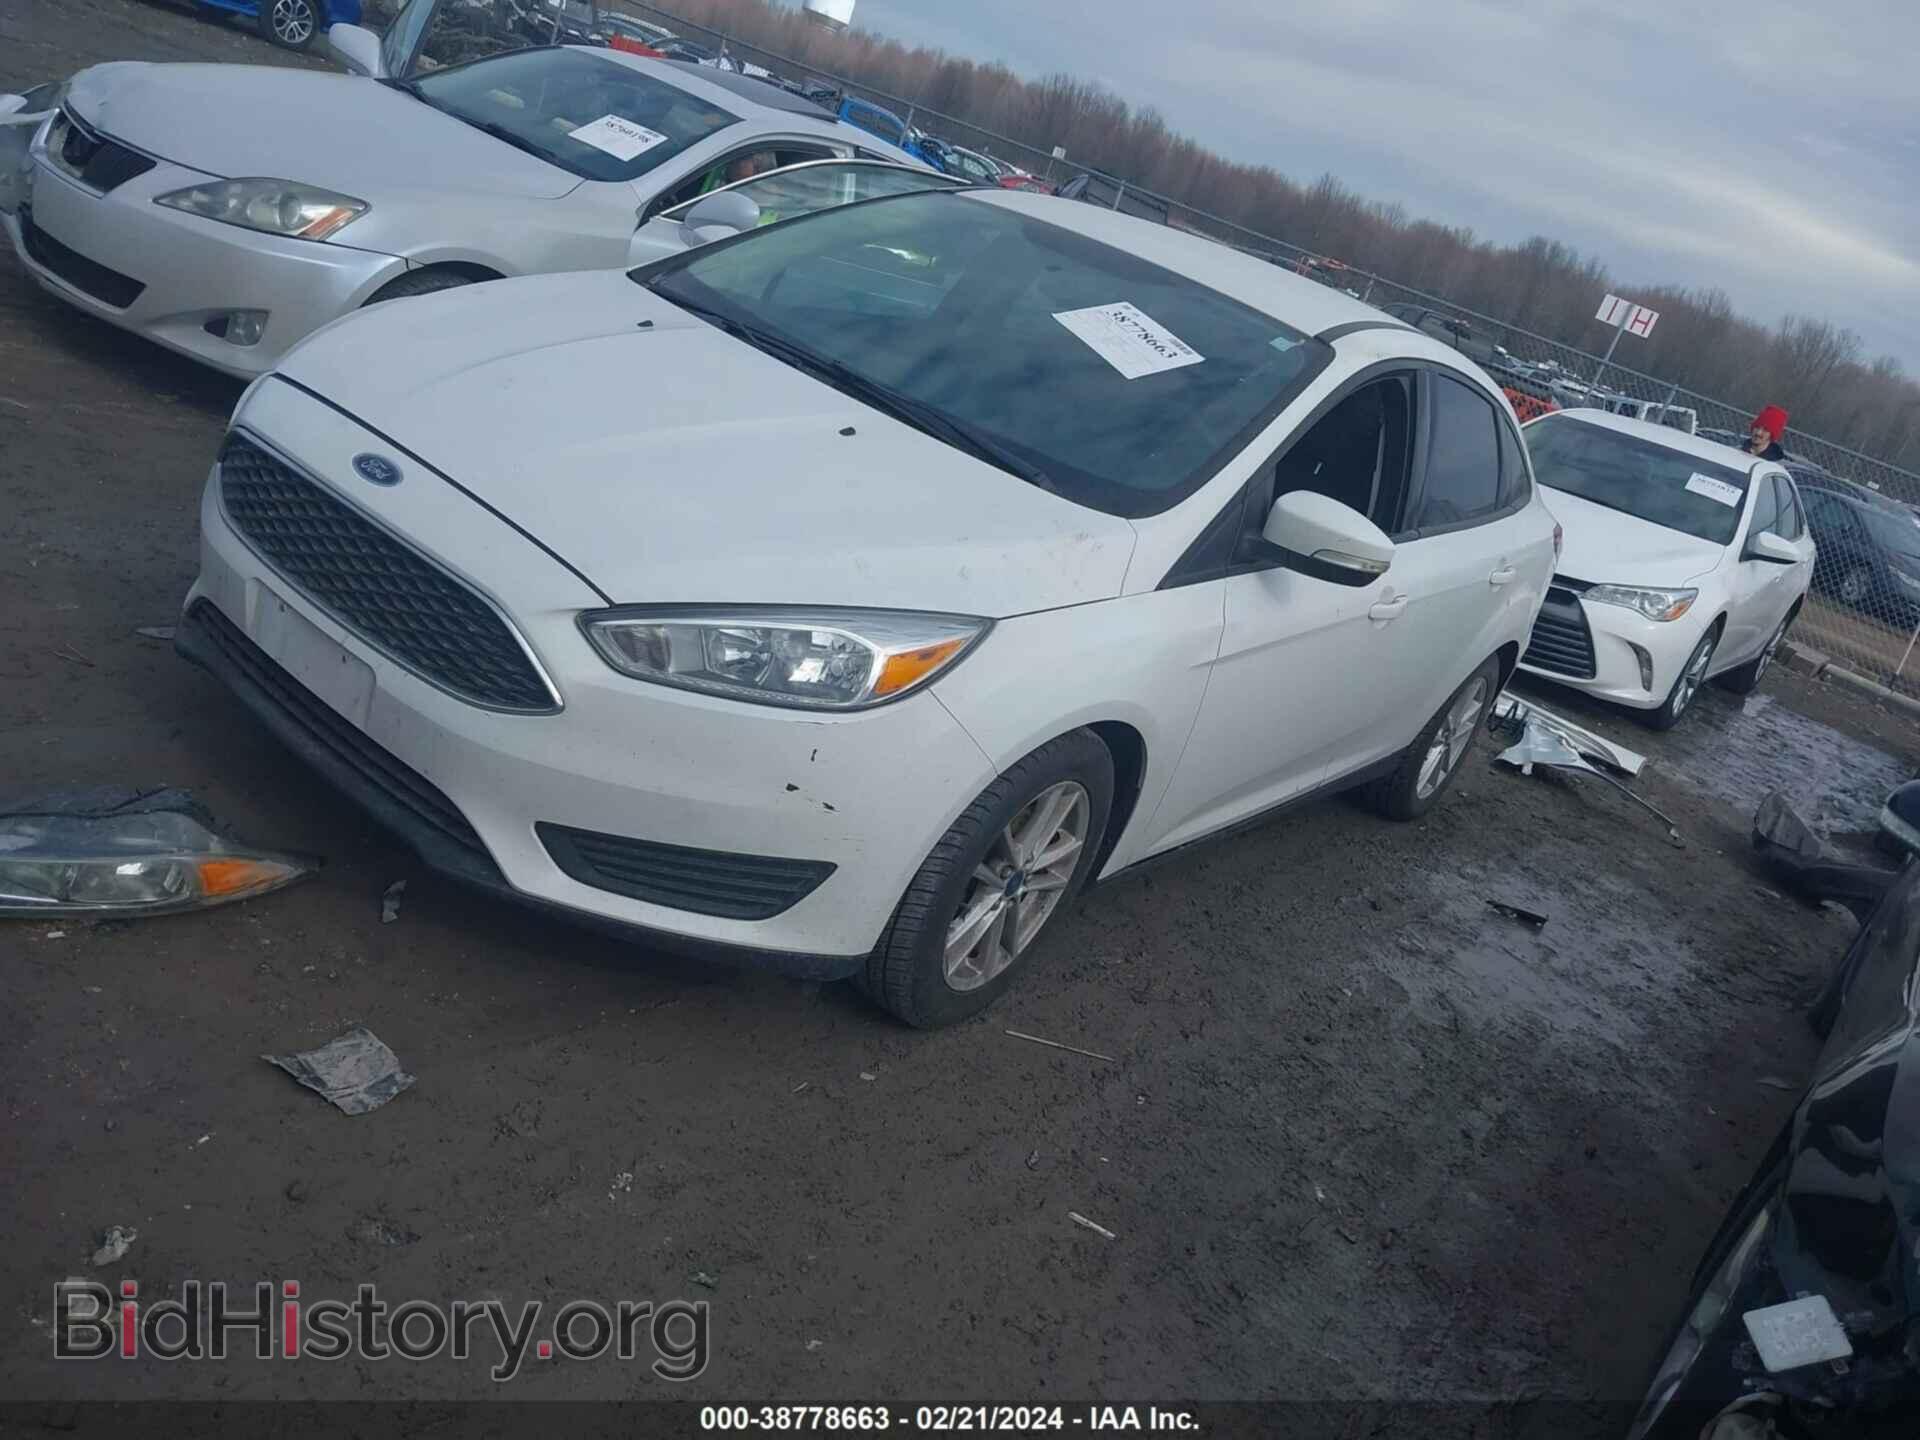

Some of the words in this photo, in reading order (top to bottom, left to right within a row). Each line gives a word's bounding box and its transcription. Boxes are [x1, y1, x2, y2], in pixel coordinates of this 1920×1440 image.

[1106, 311, 1178, 358] 38778663
[1629, 308, 1654, 335] H
[360, 459, 394, 479] Ford
